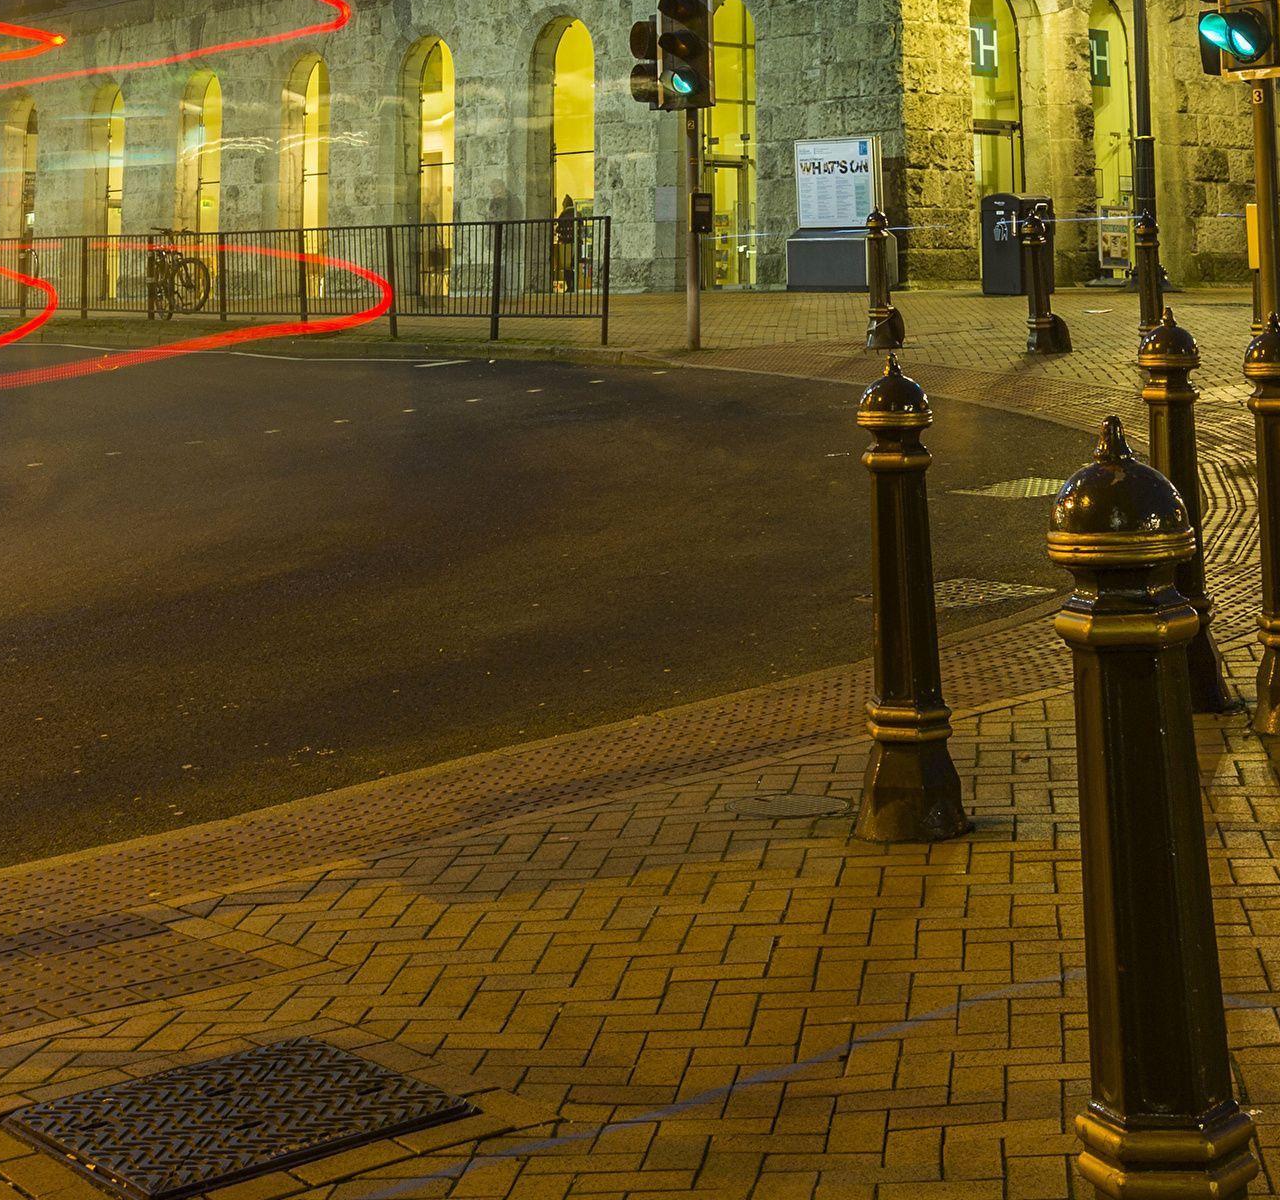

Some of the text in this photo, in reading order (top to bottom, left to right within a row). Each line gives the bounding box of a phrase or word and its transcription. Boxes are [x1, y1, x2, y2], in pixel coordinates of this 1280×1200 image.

[1254, 90, 1262, 102] 3
[800, 158, 869, 175] WHAT'S ON
